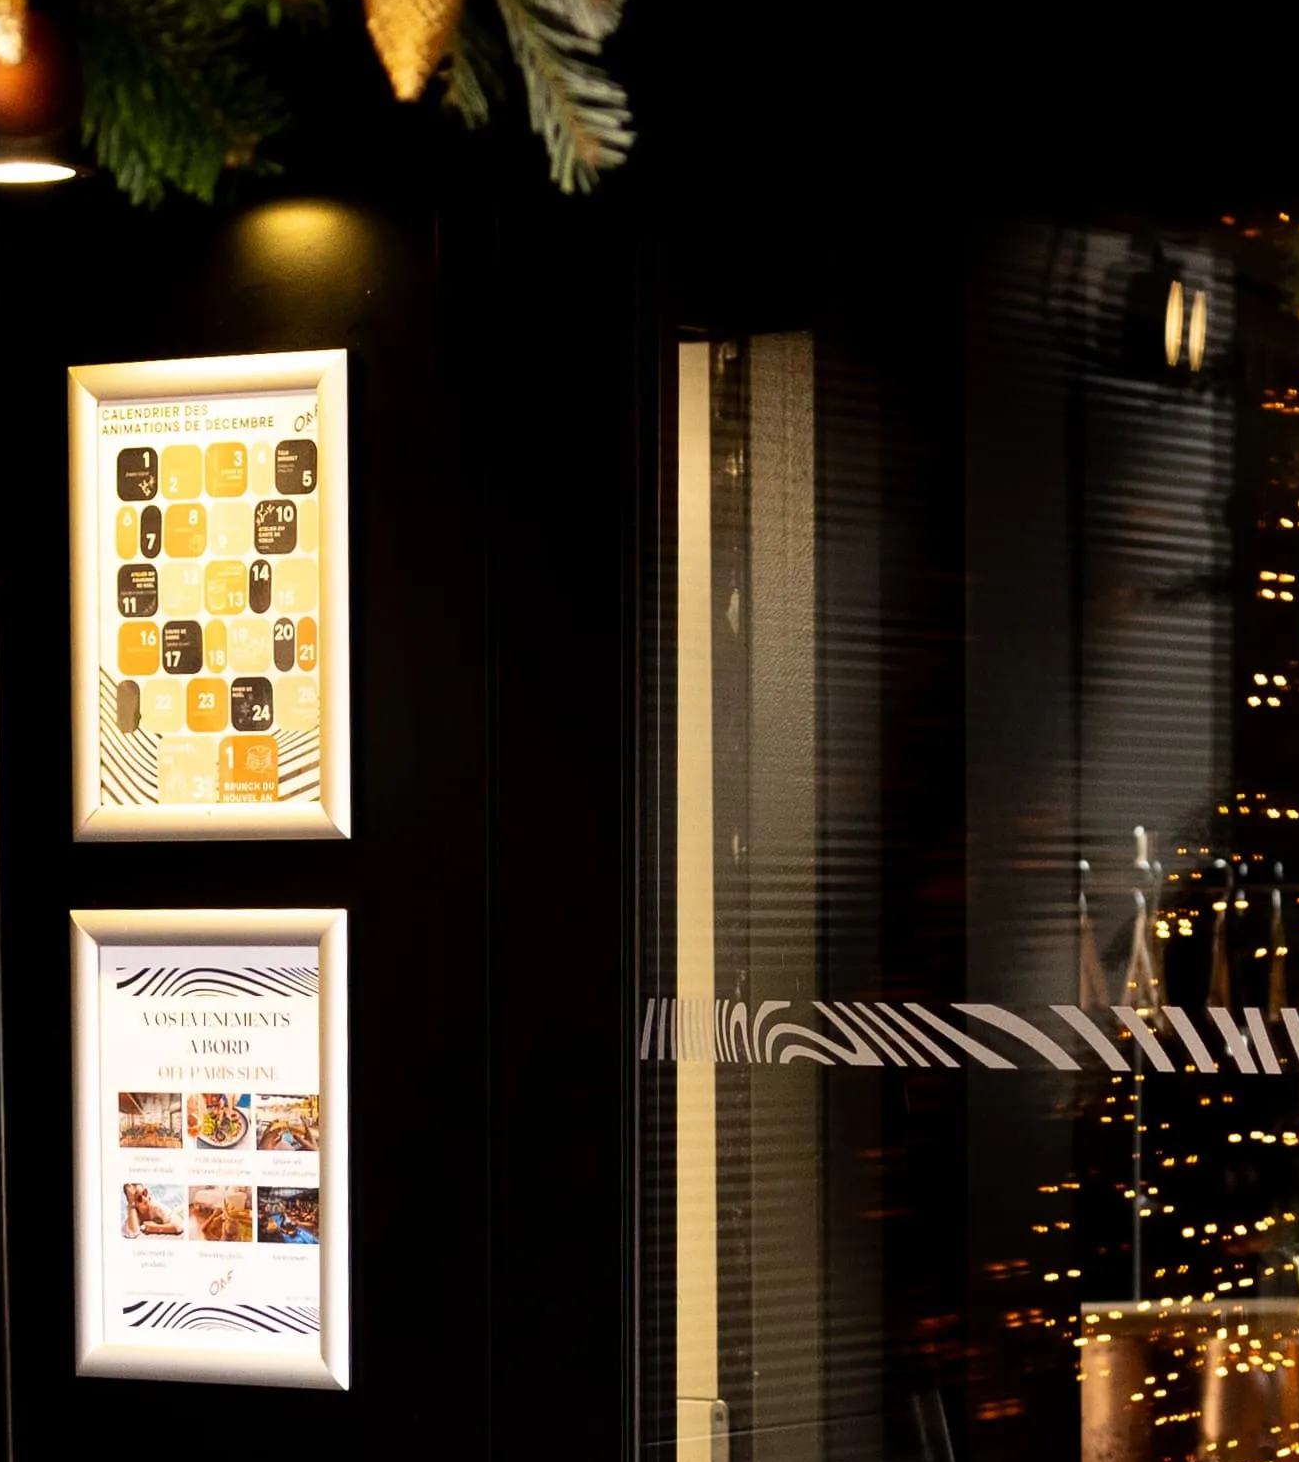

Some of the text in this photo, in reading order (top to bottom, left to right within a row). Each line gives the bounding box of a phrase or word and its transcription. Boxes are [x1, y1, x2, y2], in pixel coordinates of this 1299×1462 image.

[102, 404, 208, 420] CALENDRIER DES
[102, 420, 180, 435] ANIMATIONS
[185, 419, 200, 431] DE
[142, 452, 150, 468] 1
[234, 450, 243, 466] 3
[169, 476, 178, 492] 2
[302, 470, 312, 486] 5
[123, 511, 132, 526] 6
[188, 509, 198, 525] 8
[276, 506, 294, 522] 10
[146, 533, 156, 550] 7
[252, 564, 270, 581] 14
[122, 596, 136, 613] 11
[228, 592, 244, 607] 13
[140, 630, 156, 646] 16
[274, 624, 294, 640] 20
[165, 651, 181, 667] 17
[208, 650, 225, 666] 18
[300, 644, 315, 660] 21
[198, 693, 215, 708] 23
[252, 704, 270, 720] 24
[142, 1012, 177, 1027] VOS
[202, 1039, 250, 1054] BORD
[191, 1066, 234, 1080] PARIS
[238, 1066, 278, 1081] SEINE
